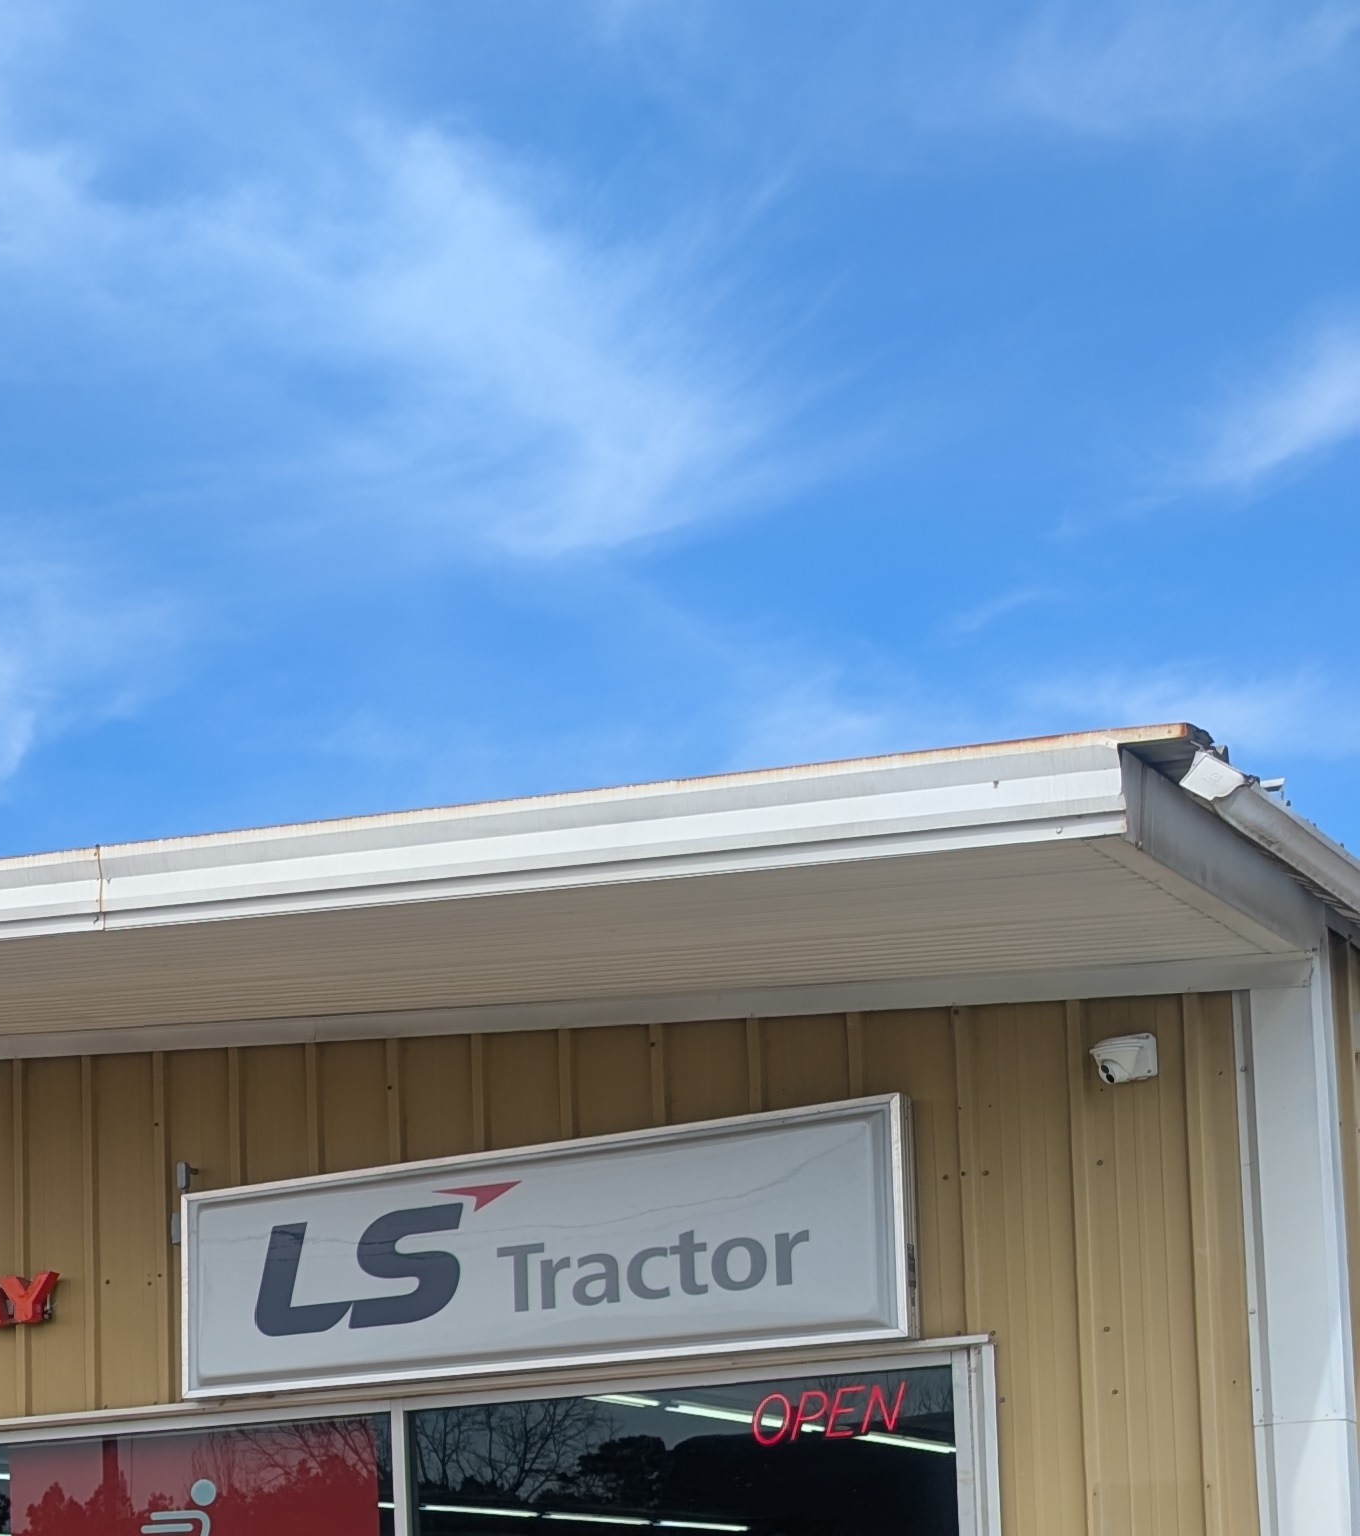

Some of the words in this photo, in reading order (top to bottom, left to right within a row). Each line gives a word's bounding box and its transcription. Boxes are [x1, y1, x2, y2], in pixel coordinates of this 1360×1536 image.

[254, 1202, 464, 1337] LS
[496, 1229, 810, 1313] Tractor
[751, 1380, 906, 1446] OPEN
